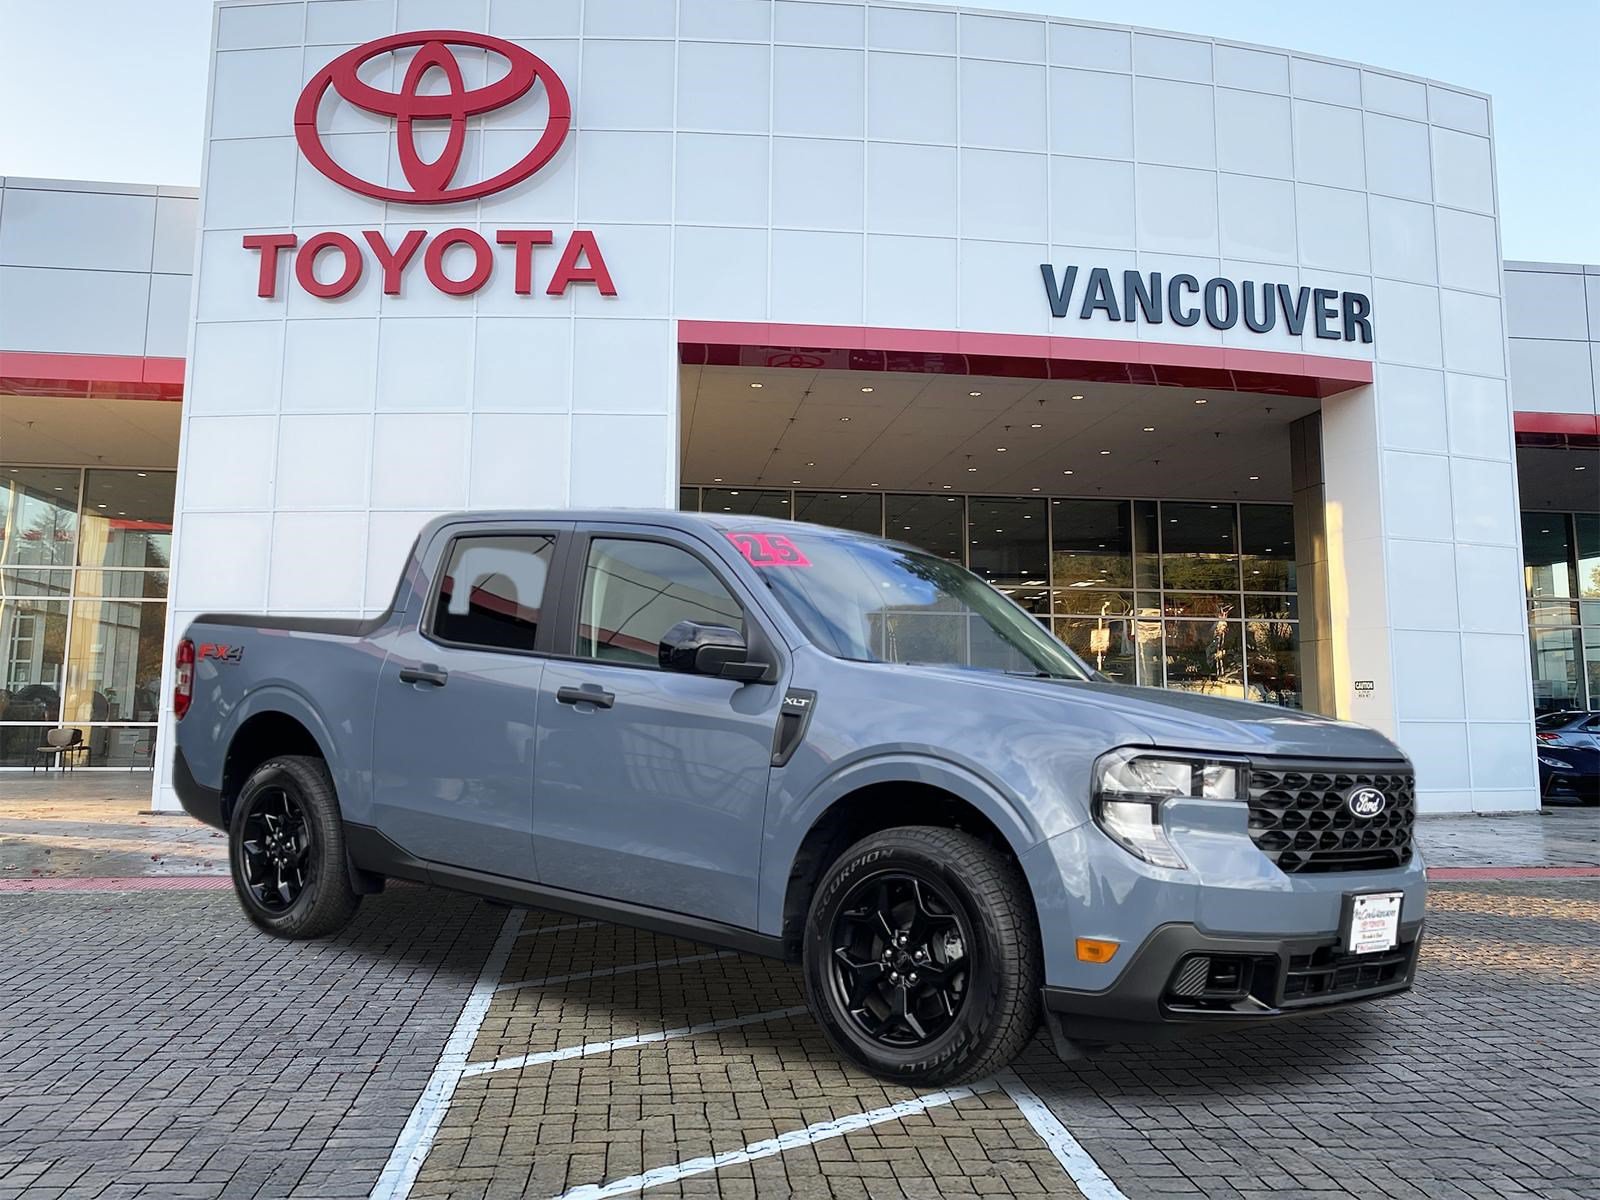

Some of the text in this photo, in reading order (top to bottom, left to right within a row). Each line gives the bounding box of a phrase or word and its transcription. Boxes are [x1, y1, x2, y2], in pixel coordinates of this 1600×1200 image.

[243, 228, 617, 298] TOYOTA
[1040, 263, 1373, 343] VANCOUVER
[735, 535, 799, 561] 25
[198, 643, 245, 662] FX4
[784, 697, 809, 706] XLT
[1356, 792, 1380, 812] Ford
